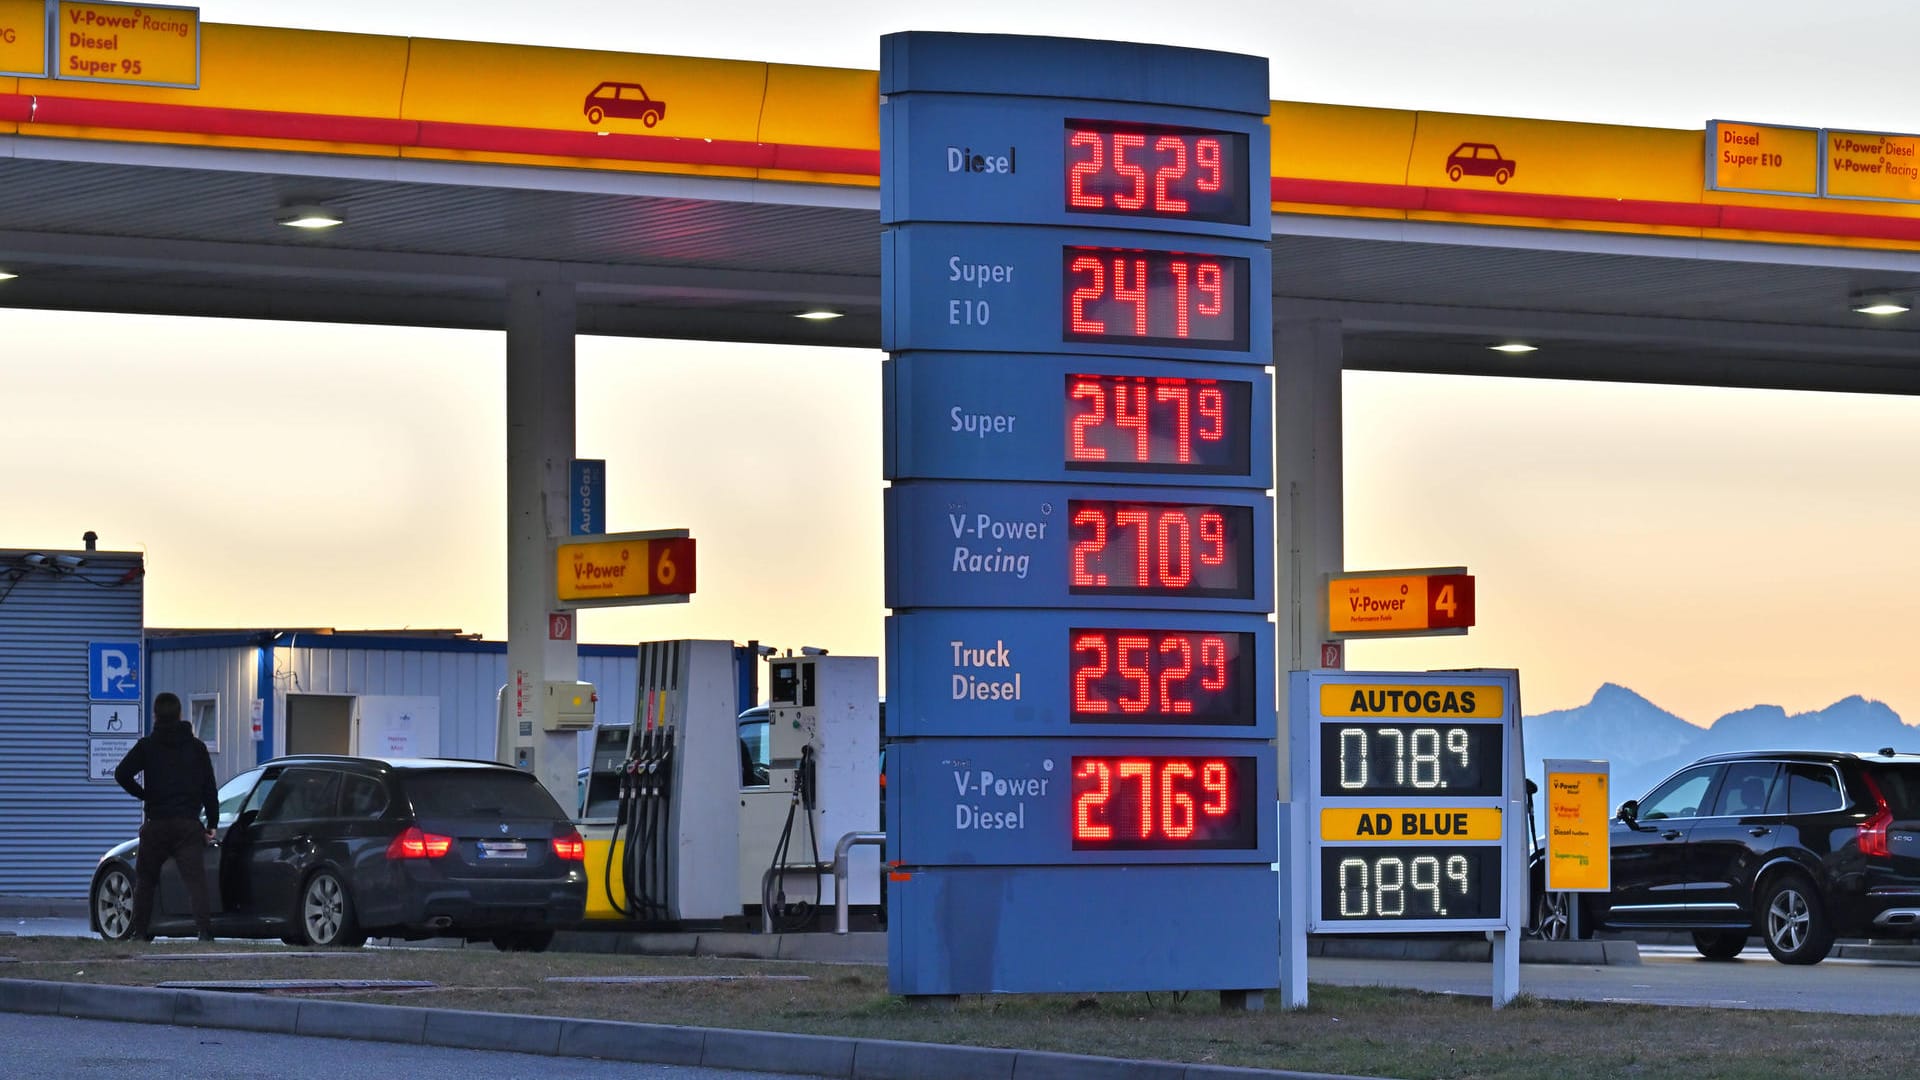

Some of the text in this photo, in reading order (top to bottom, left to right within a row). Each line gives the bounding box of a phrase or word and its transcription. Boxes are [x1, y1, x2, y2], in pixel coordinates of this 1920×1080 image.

[0, 28, 16, 43] G
[69, 10, 188, 37] V-Power Racing
[69, 33, 118, 50] Diesel
[69, 56, 141, 75] Super 95
[1724, 131, 1759, 146] Diesel
[1834, 138, 1915, 157] V-Power Diesel
[948, 147, 1015, 174] Diesel
[1724, 151, 1782, 168] Super E10
[1834, 158, 1918, 180] V-Power Racing
[949, 256, 1014, 288] Super
[949, 300, 990, 326] E10
[951, 406, 1016, 438] Super
[580, 466, 591, 533] AutoGas
[949, 513, 1048, 540] V-Power
[574, 562, 626, 579] V-Power
[657, 548, 676, 585] 6
[952, 546, 1030, 579] Racing
[1350, 596, 1406, 612] V-Power
[1435, 584, 1457, 618] 4
[951, 639, 1010, 667] Truck
[101, 649, 130, 693] P
[952, 673, 1021, 701] Diesel
[1350, 690, 1476, 714] AUTOGAS
[954, 771, 1049, 796] V-Power
[956, 802, 1025, 830] Diesel
[1356, 813, 1469, 836] AD BLUE
